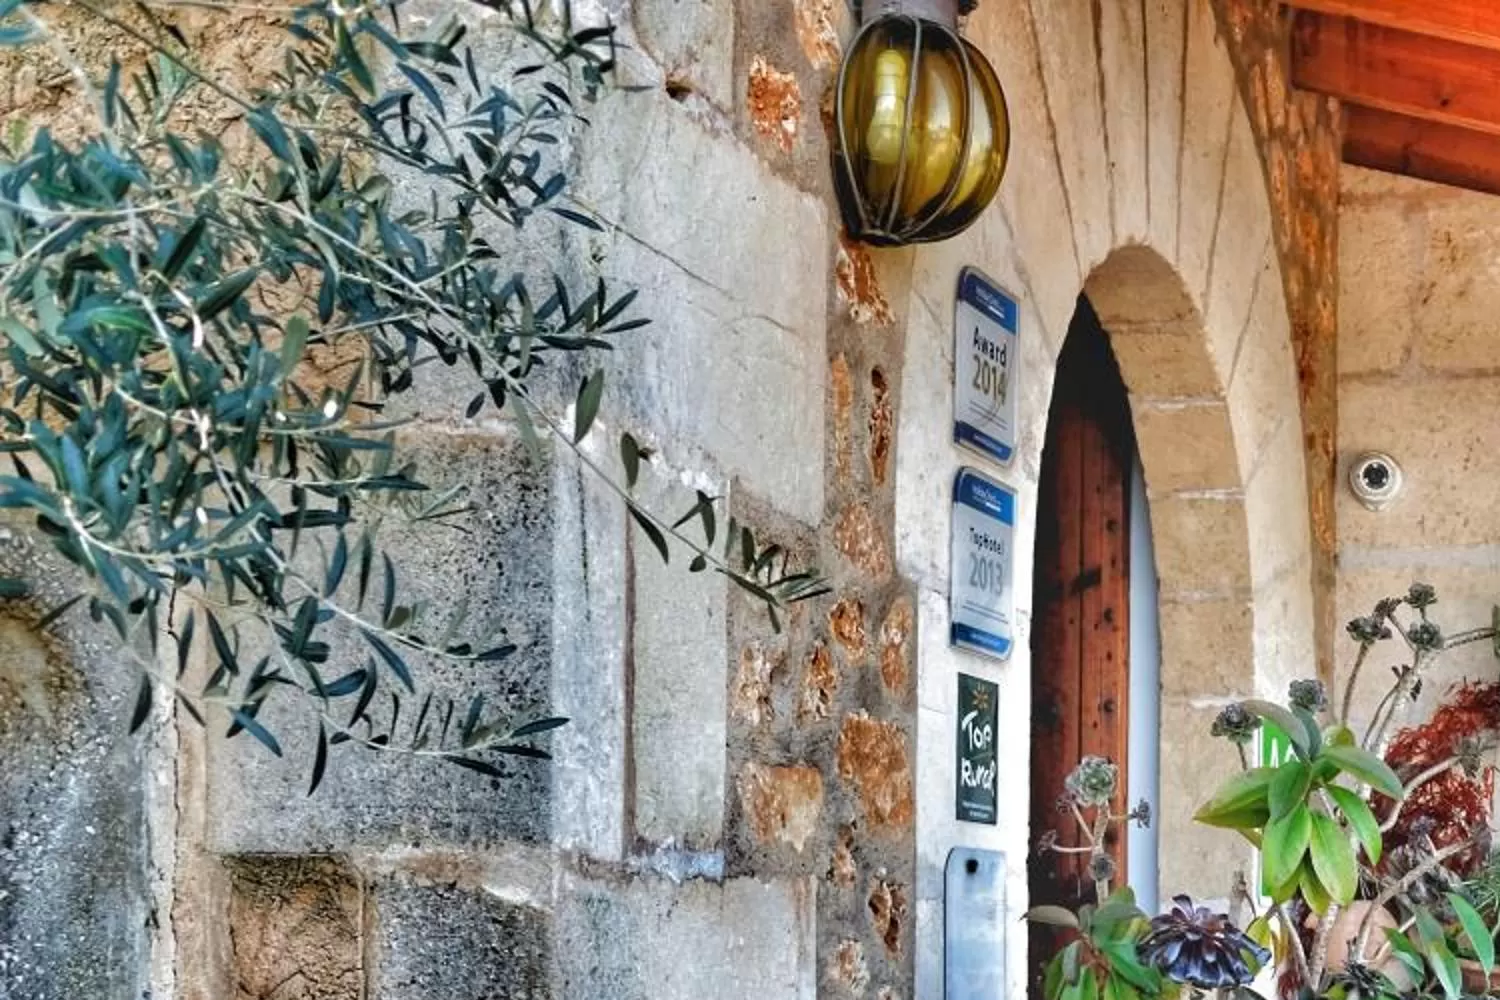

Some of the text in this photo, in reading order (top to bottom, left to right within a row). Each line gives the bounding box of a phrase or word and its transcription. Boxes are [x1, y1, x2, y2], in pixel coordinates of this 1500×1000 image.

[973, 326, 1007, 368] Award
[972, 353, 1007, 406] 2014
[969, 552, 1003, 597] 2013
[961, 710, 993, 751] Top
[961, 757, 997, 798] Rural
